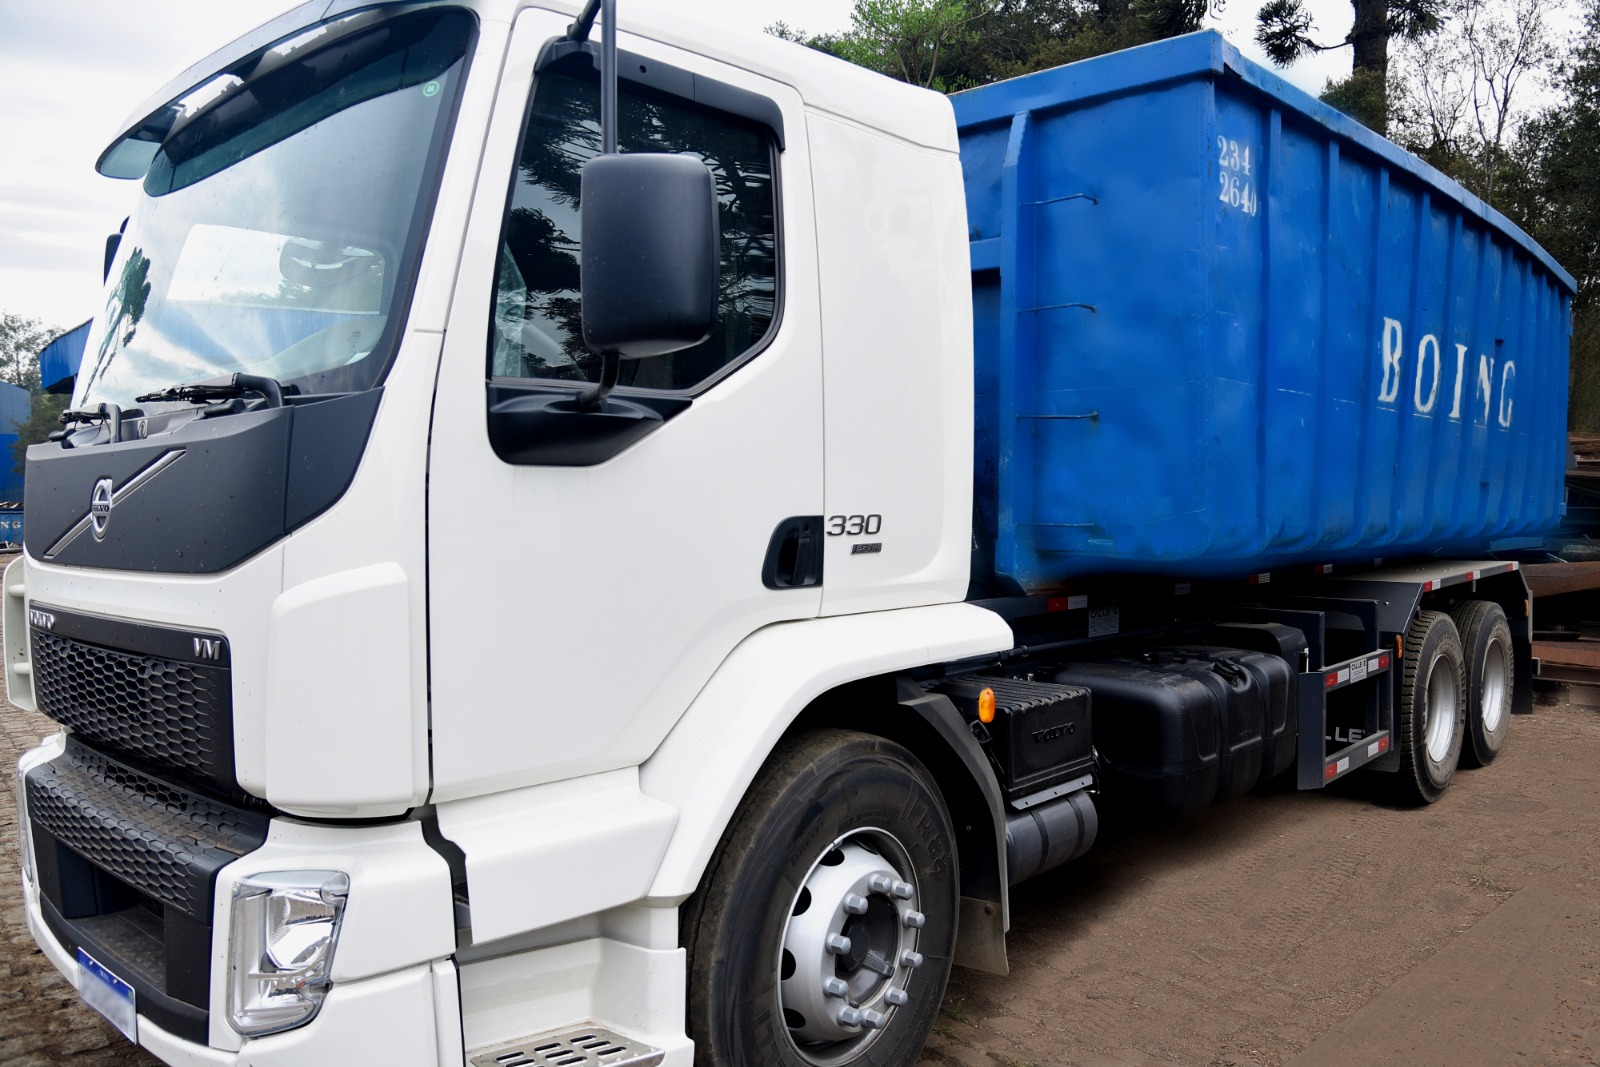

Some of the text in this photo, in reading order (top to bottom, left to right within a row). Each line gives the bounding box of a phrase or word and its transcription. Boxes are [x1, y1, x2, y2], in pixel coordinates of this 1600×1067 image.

[1217, 135, 1251, 176] 234
[1219, 171, 1257, 217] 2640
[1378, 316, 1516, 428] BOING
[826, 514, 882, 536] 330
[193, 637, 221, 660] VM
